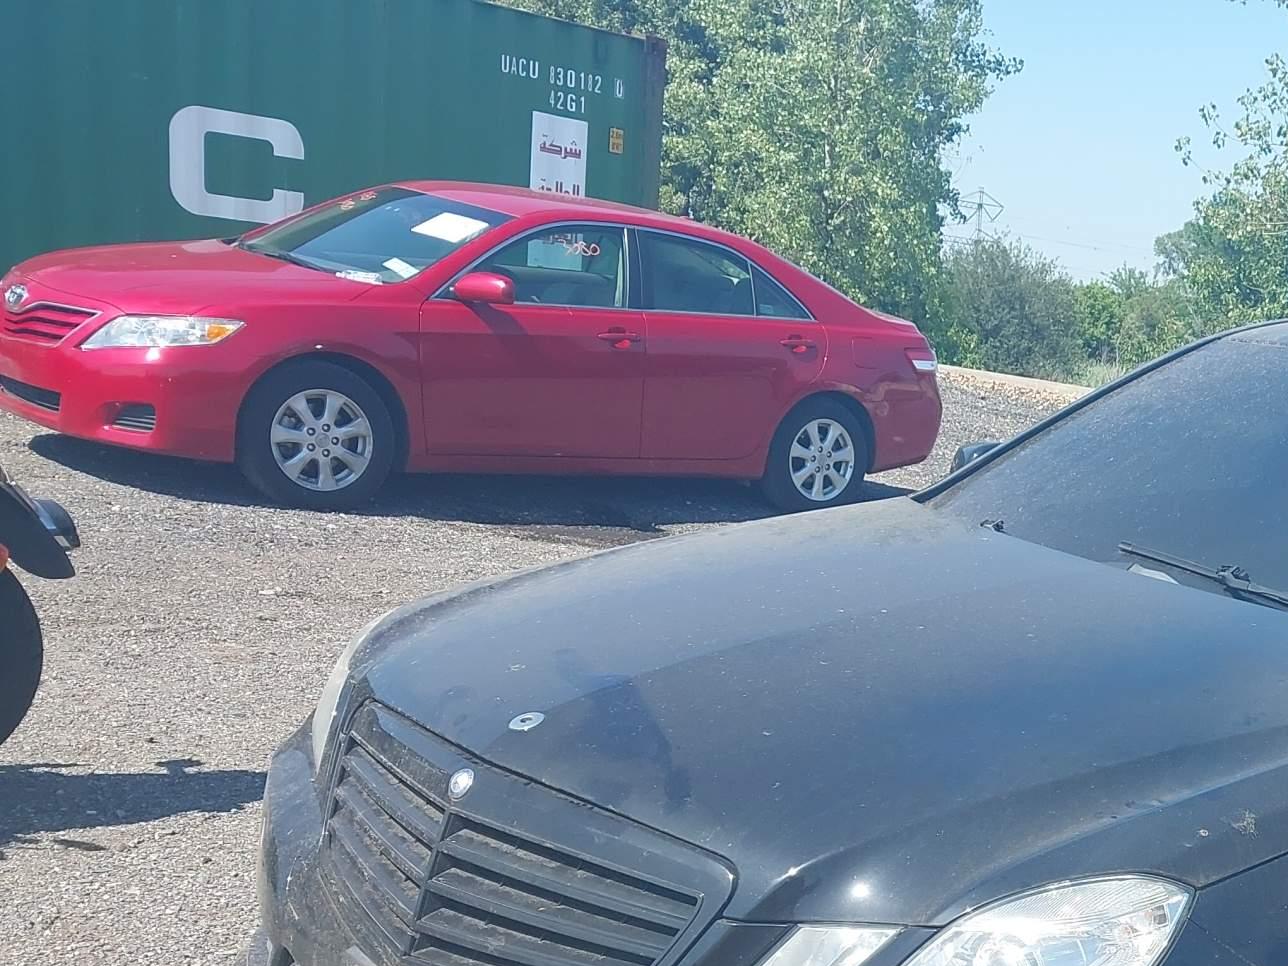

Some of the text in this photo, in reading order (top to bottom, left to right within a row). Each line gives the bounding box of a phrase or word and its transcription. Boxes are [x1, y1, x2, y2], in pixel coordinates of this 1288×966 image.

[501, 54, 540, 79] UACU
[549, 66, 602, 94] 830182
[549, 90, 586, 113] 42G1
[168, 105, 305, 225] C
